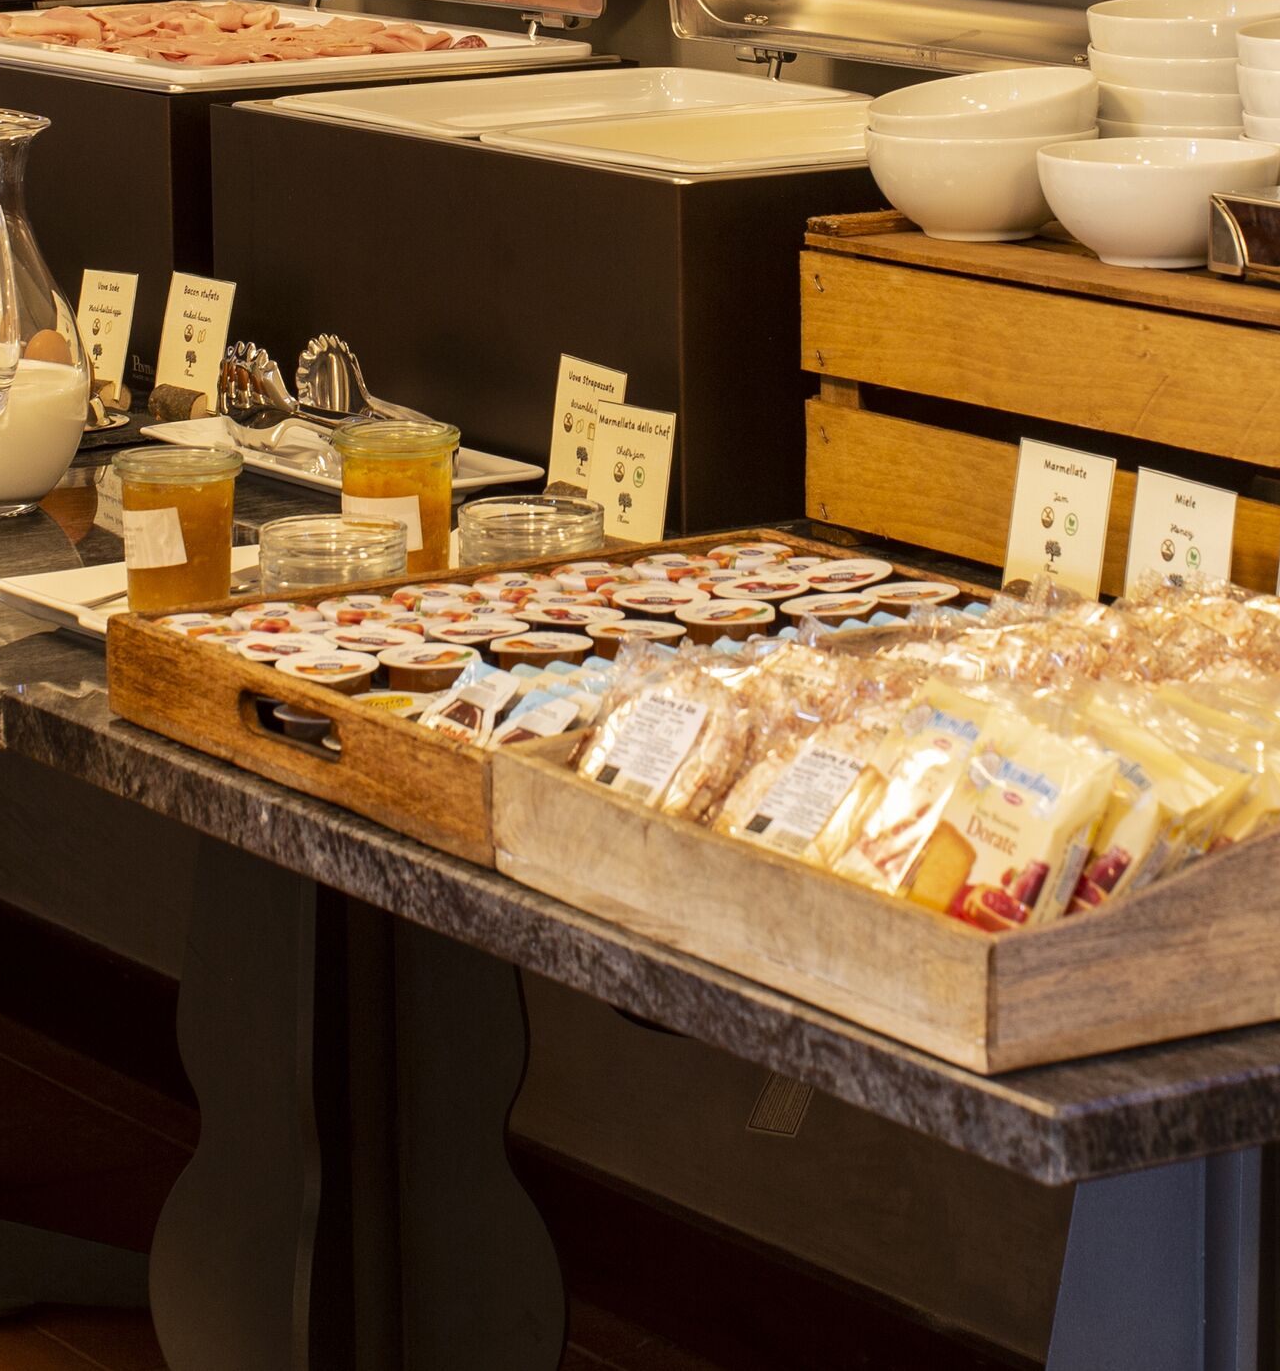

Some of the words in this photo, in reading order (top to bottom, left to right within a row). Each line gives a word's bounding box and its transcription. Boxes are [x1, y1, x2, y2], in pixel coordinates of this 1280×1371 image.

[109, 282, 120, 294] Sode
[183, 285, 199, 297] Bacon
[200, 287, 220, 302] stufato
[568, 370, 581, 383] Uova
[582, 375, 615, 394] Strapazzate
[599, 414, 635, 430] Marmellata
[636, 420, 653, 434] dello
[654, 424, 671, 440] Chef
[1043, 458, 1087, 480] Marmellate
[1053, 492, 1069, 504] Jam
[1174, 493, 1197, 509] Miele
[967, 815, 1019, 857] Dorate
